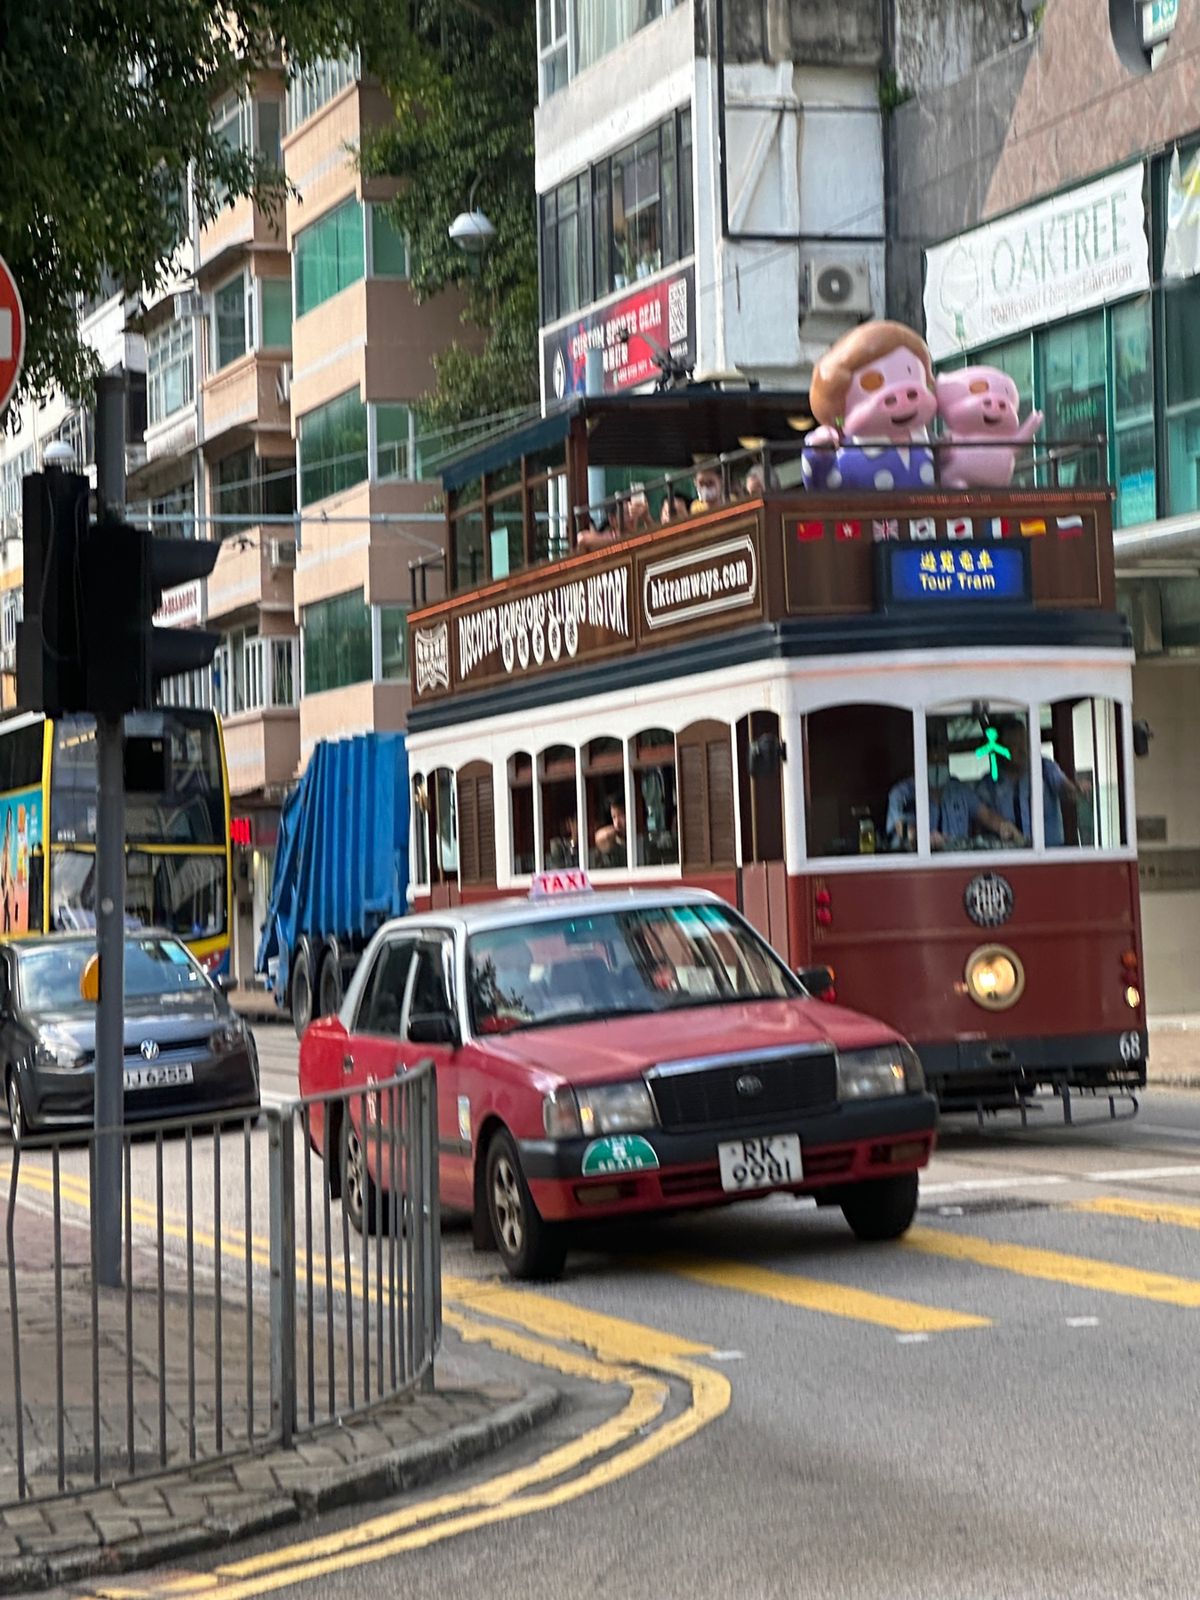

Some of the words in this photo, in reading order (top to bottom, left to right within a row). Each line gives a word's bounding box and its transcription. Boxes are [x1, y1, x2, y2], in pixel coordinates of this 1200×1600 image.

[992, 191, 1129, 294] OAKTREE
[572, 323, 605, 359] CUSTOM
[638, 298, 662, 332] GEAR
[651, 559, 748, 609] hktramways.com
[919, 572, 953, 591] Tour
[957, 572, 996, 591] Tram
[459, 606, 498, 680] DISCOVER
[555, 580, 586, 624] LIVING
[587, 566, 629, 637] HISTORY
[540, 872, 586, 894] TAXI
[1119, 1030, 1141, 1061] 68
[741, 1136, 779, 1165] RK
